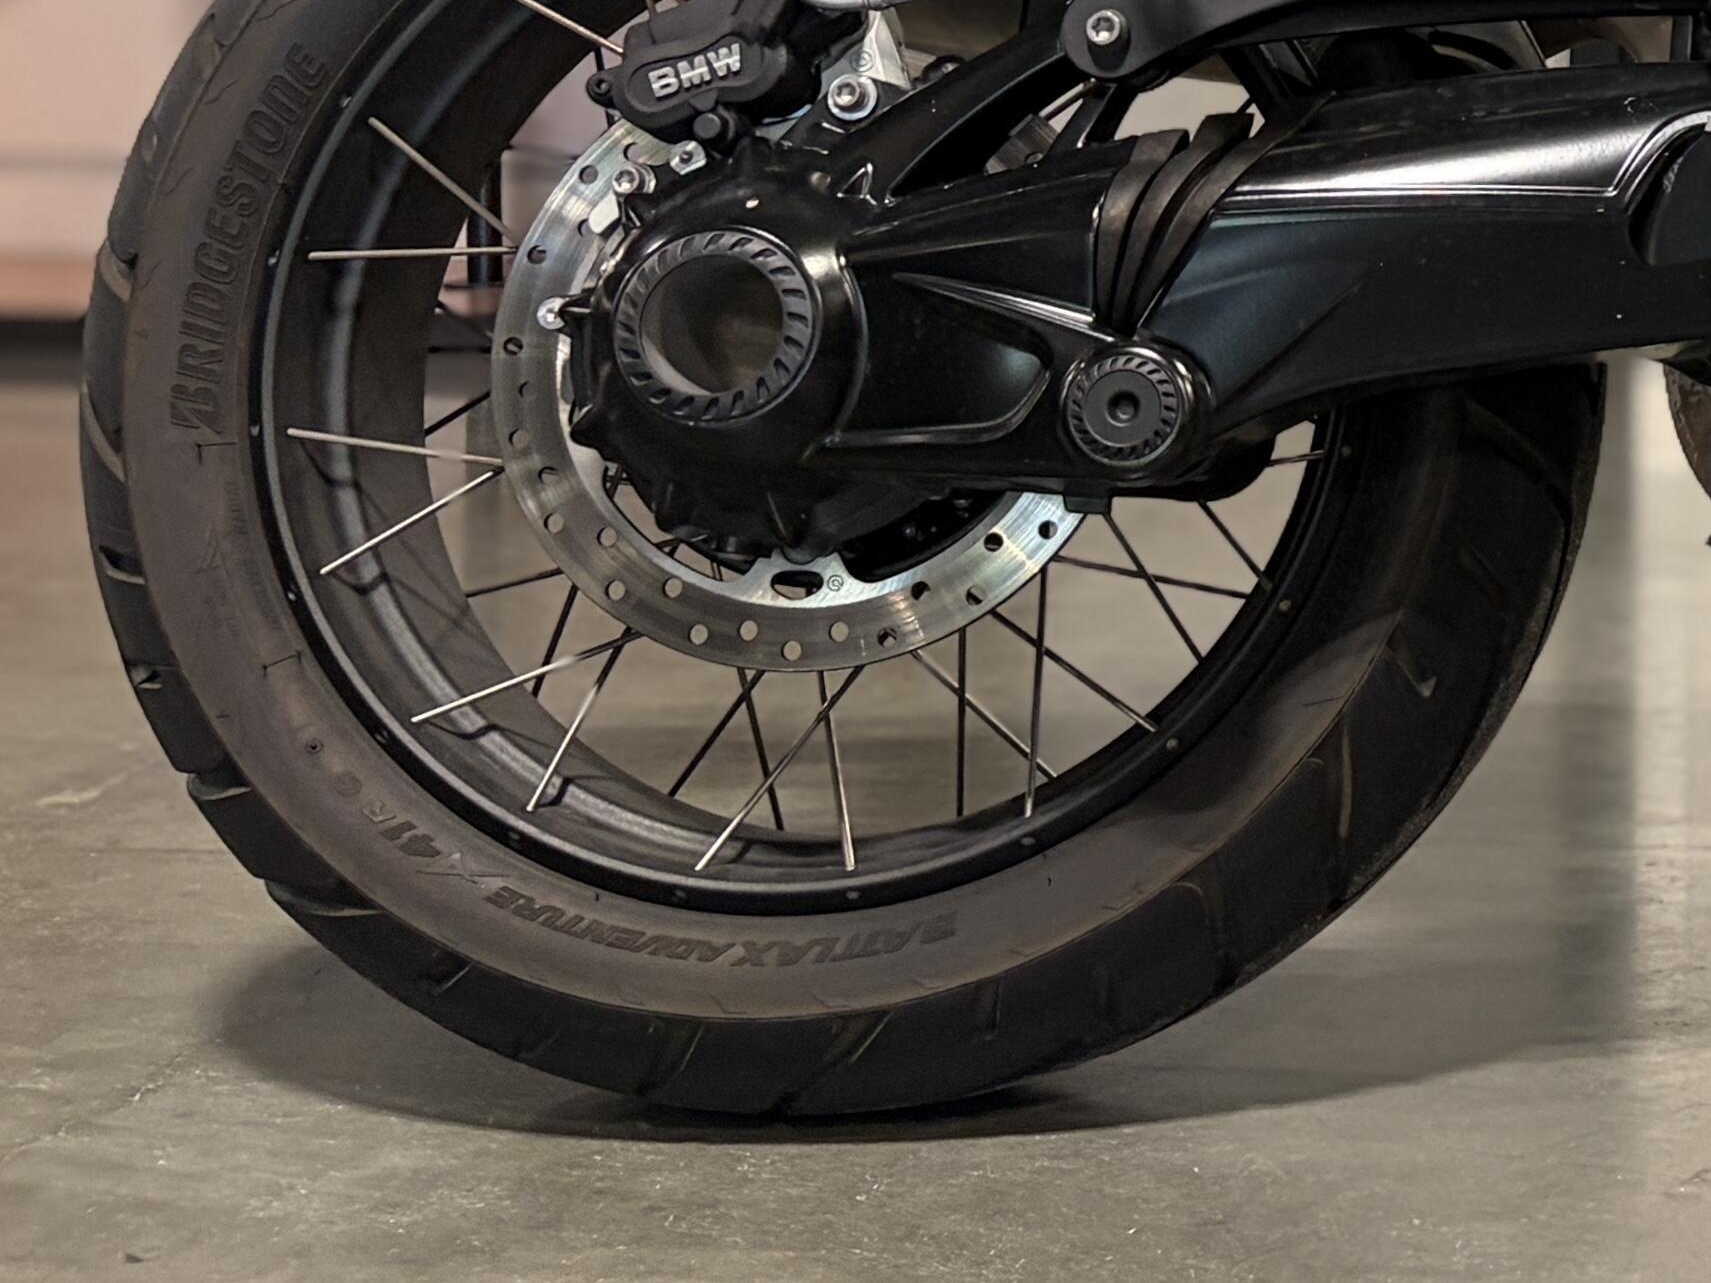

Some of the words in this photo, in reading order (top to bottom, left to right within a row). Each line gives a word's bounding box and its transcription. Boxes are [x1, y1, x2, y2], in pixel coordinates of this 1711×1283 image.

[647, 42, 742, 98] BMW
[168, 41, 330, 436] BRIDGESTONE
[483, 885, 734, 965] ADVENTURE
[731, 911, 960, 968] BATTLAX
